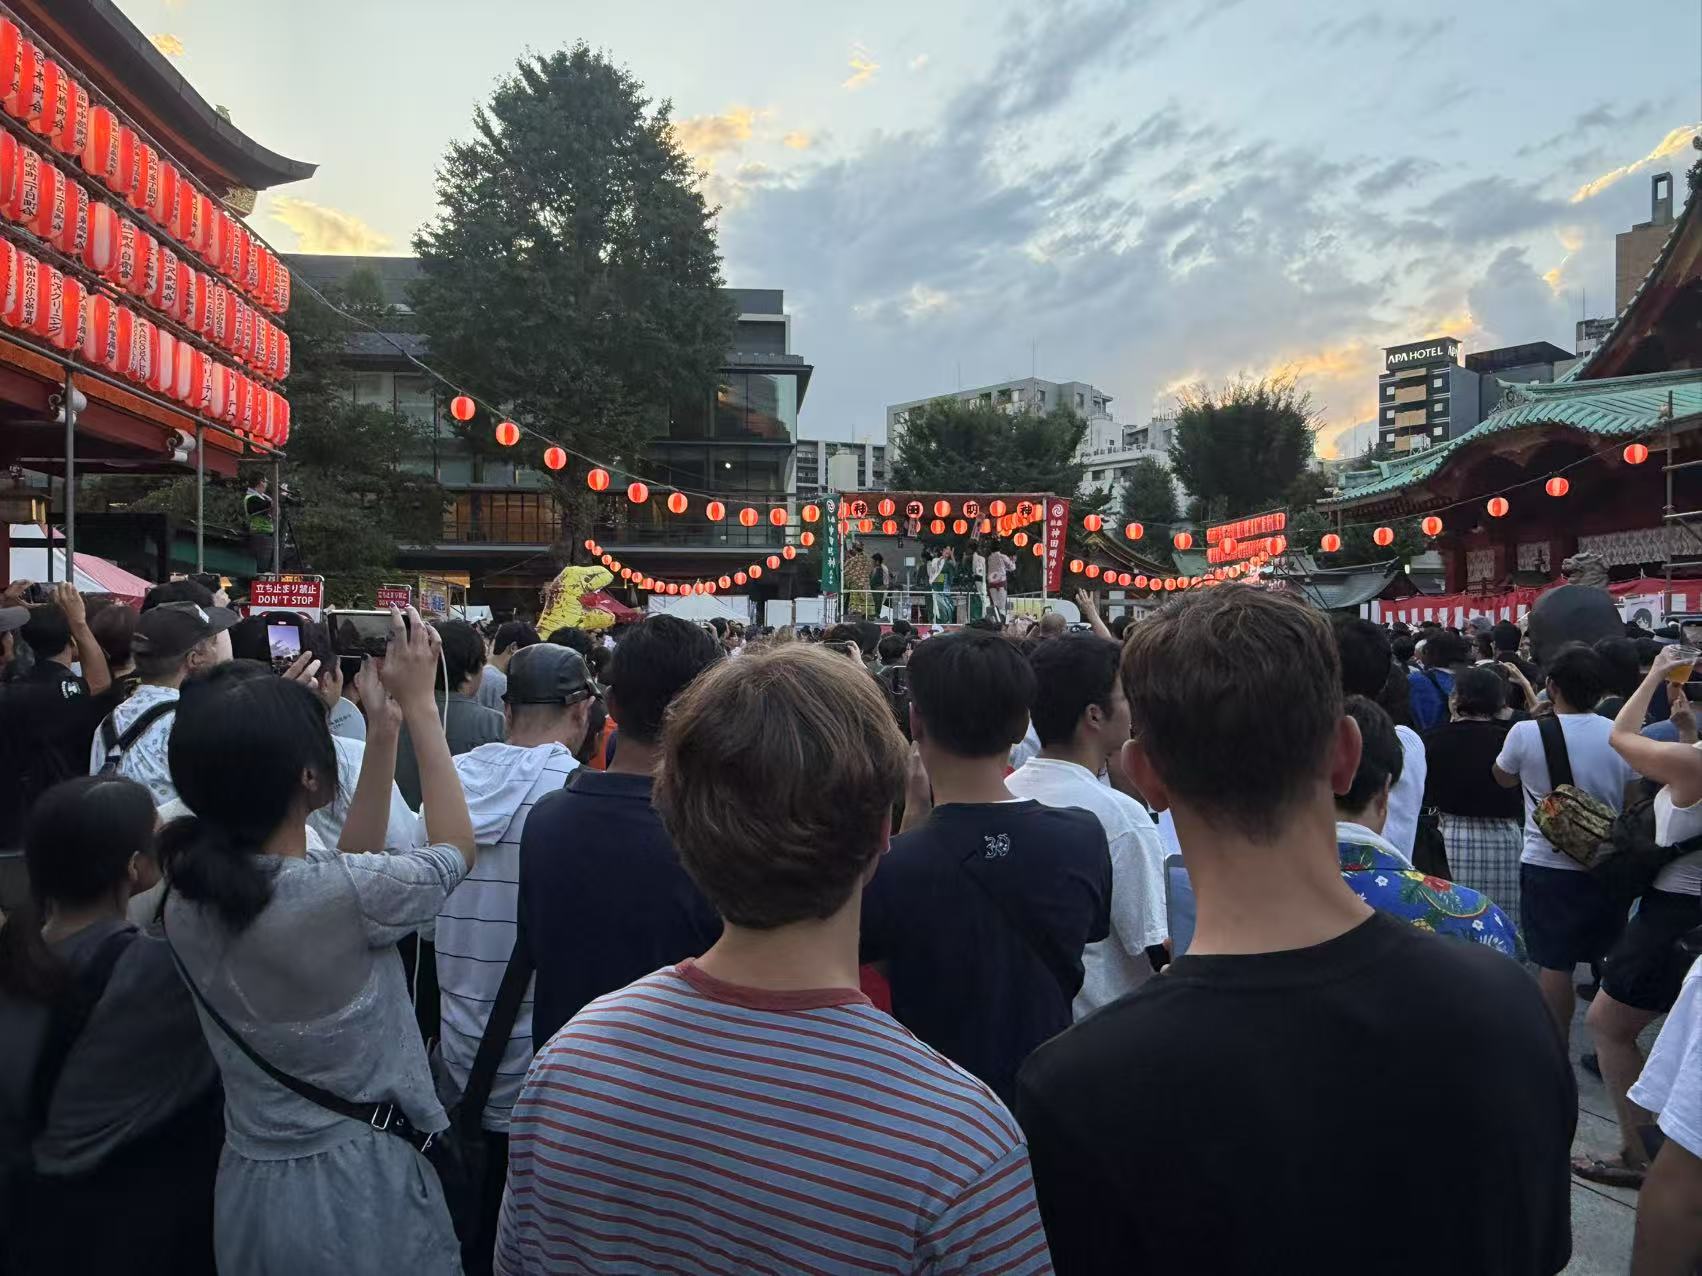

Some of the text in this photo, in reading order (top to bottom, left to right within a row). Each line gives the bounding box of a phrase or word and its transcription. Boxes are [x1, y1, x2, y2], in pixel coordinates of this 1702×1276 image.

[1388, 346, 1444, 364] APA HOTEL
[854, 502, 1032, 516] 神 田 明 神
[1049, 528, 1060, 569] 神田明神
[256, 584, 316, 594] 立ち止まり禁止
[258, 595, 314, 604] DON'T STOP
